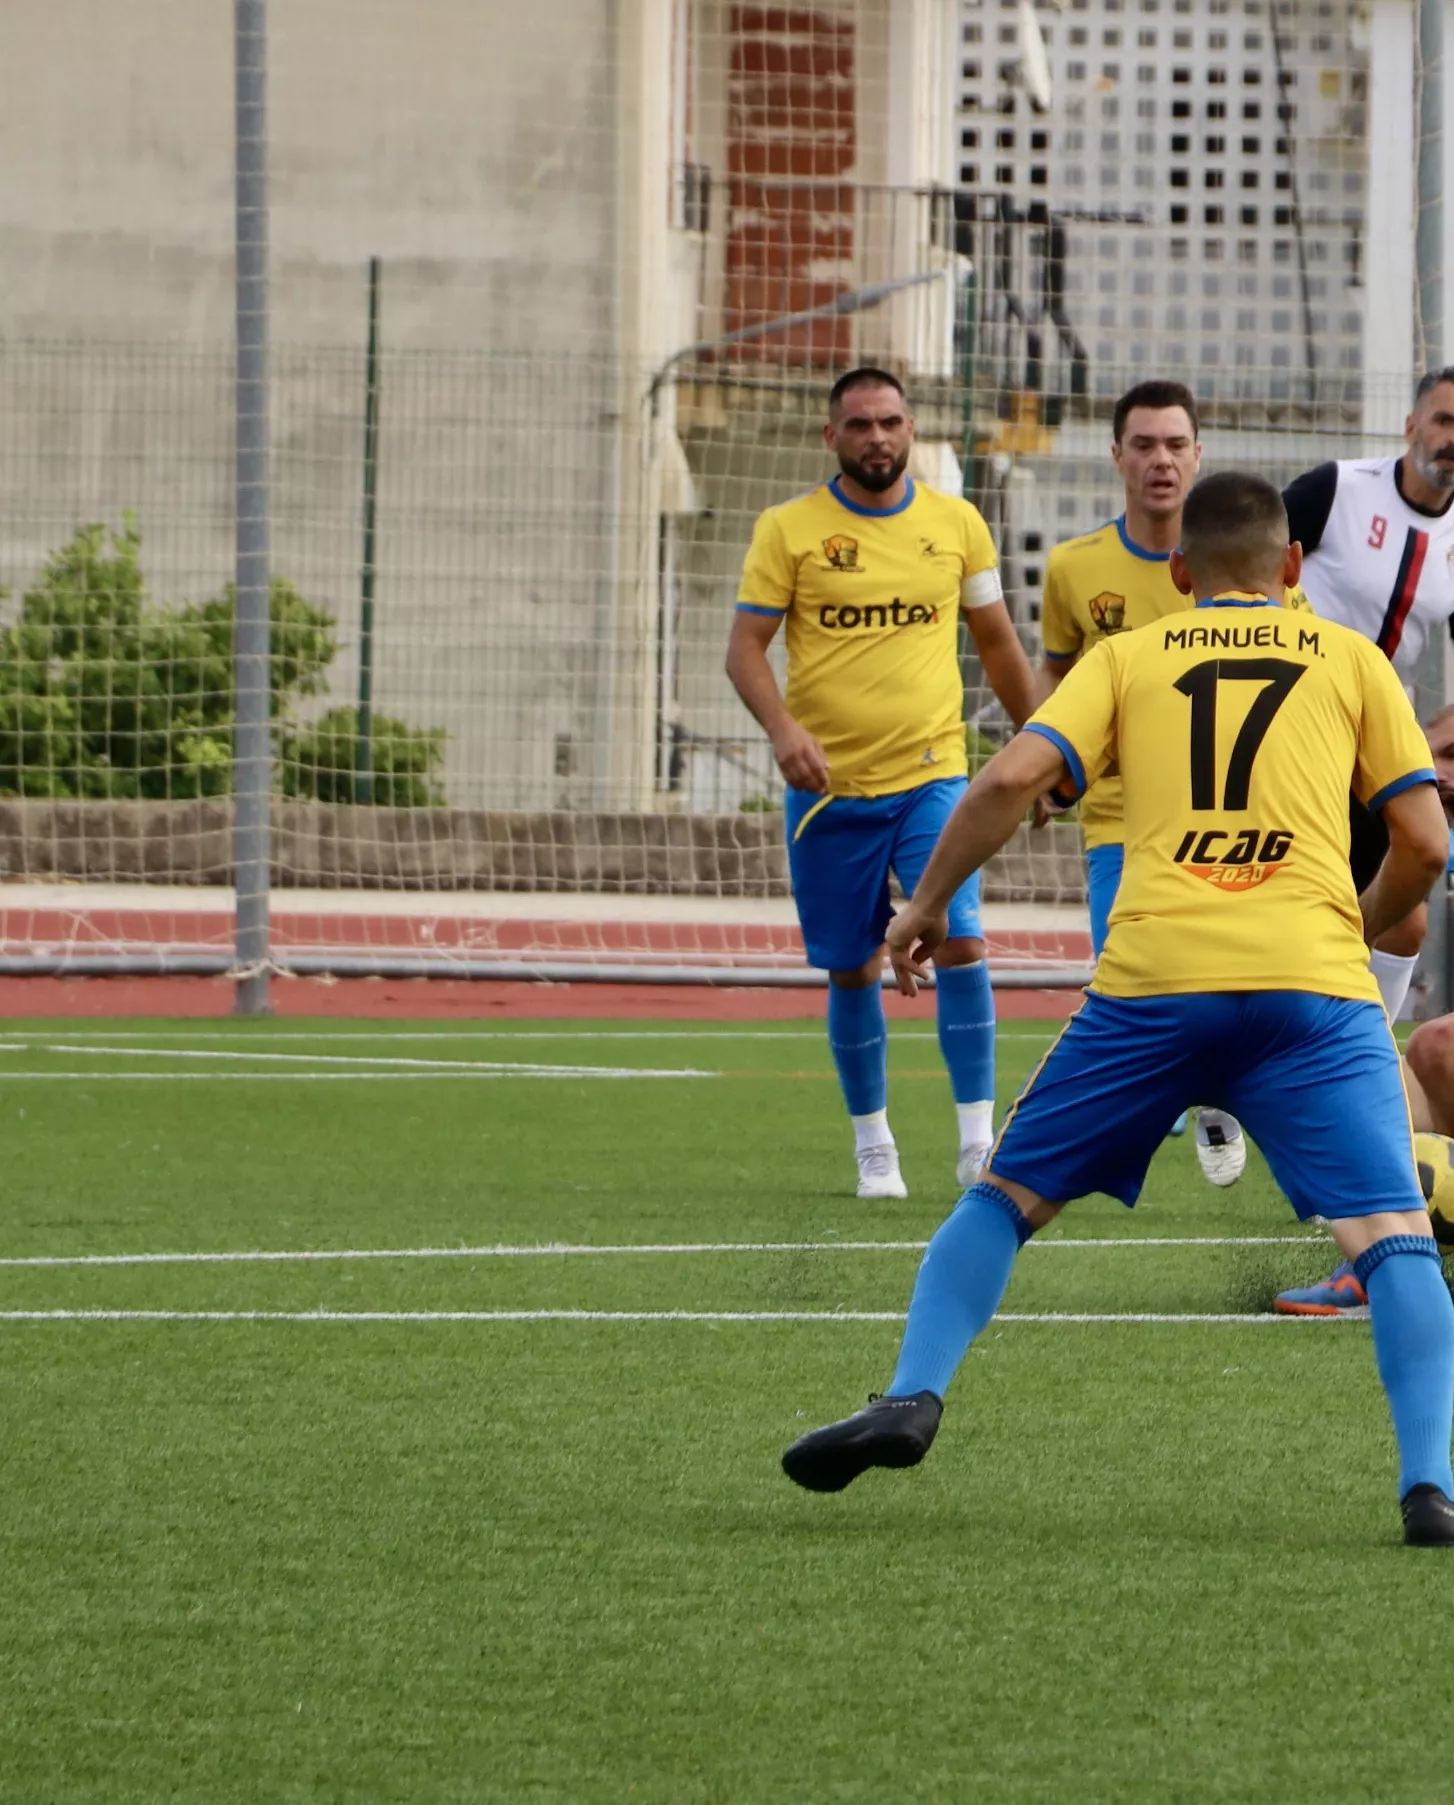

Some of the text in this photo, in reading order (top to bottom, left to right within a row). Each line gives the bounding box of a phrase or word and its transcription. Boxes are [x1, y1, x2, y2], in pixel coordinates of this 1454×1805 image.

[1367, 514, 1388, 551] 9
[1164, 625, 1326, 659] MANUEL M.
[1172, 658, 1309, 811] 17
[1173, 829, 1294, 865] ICAG
[1206, 865, 1266, 883] 2020
